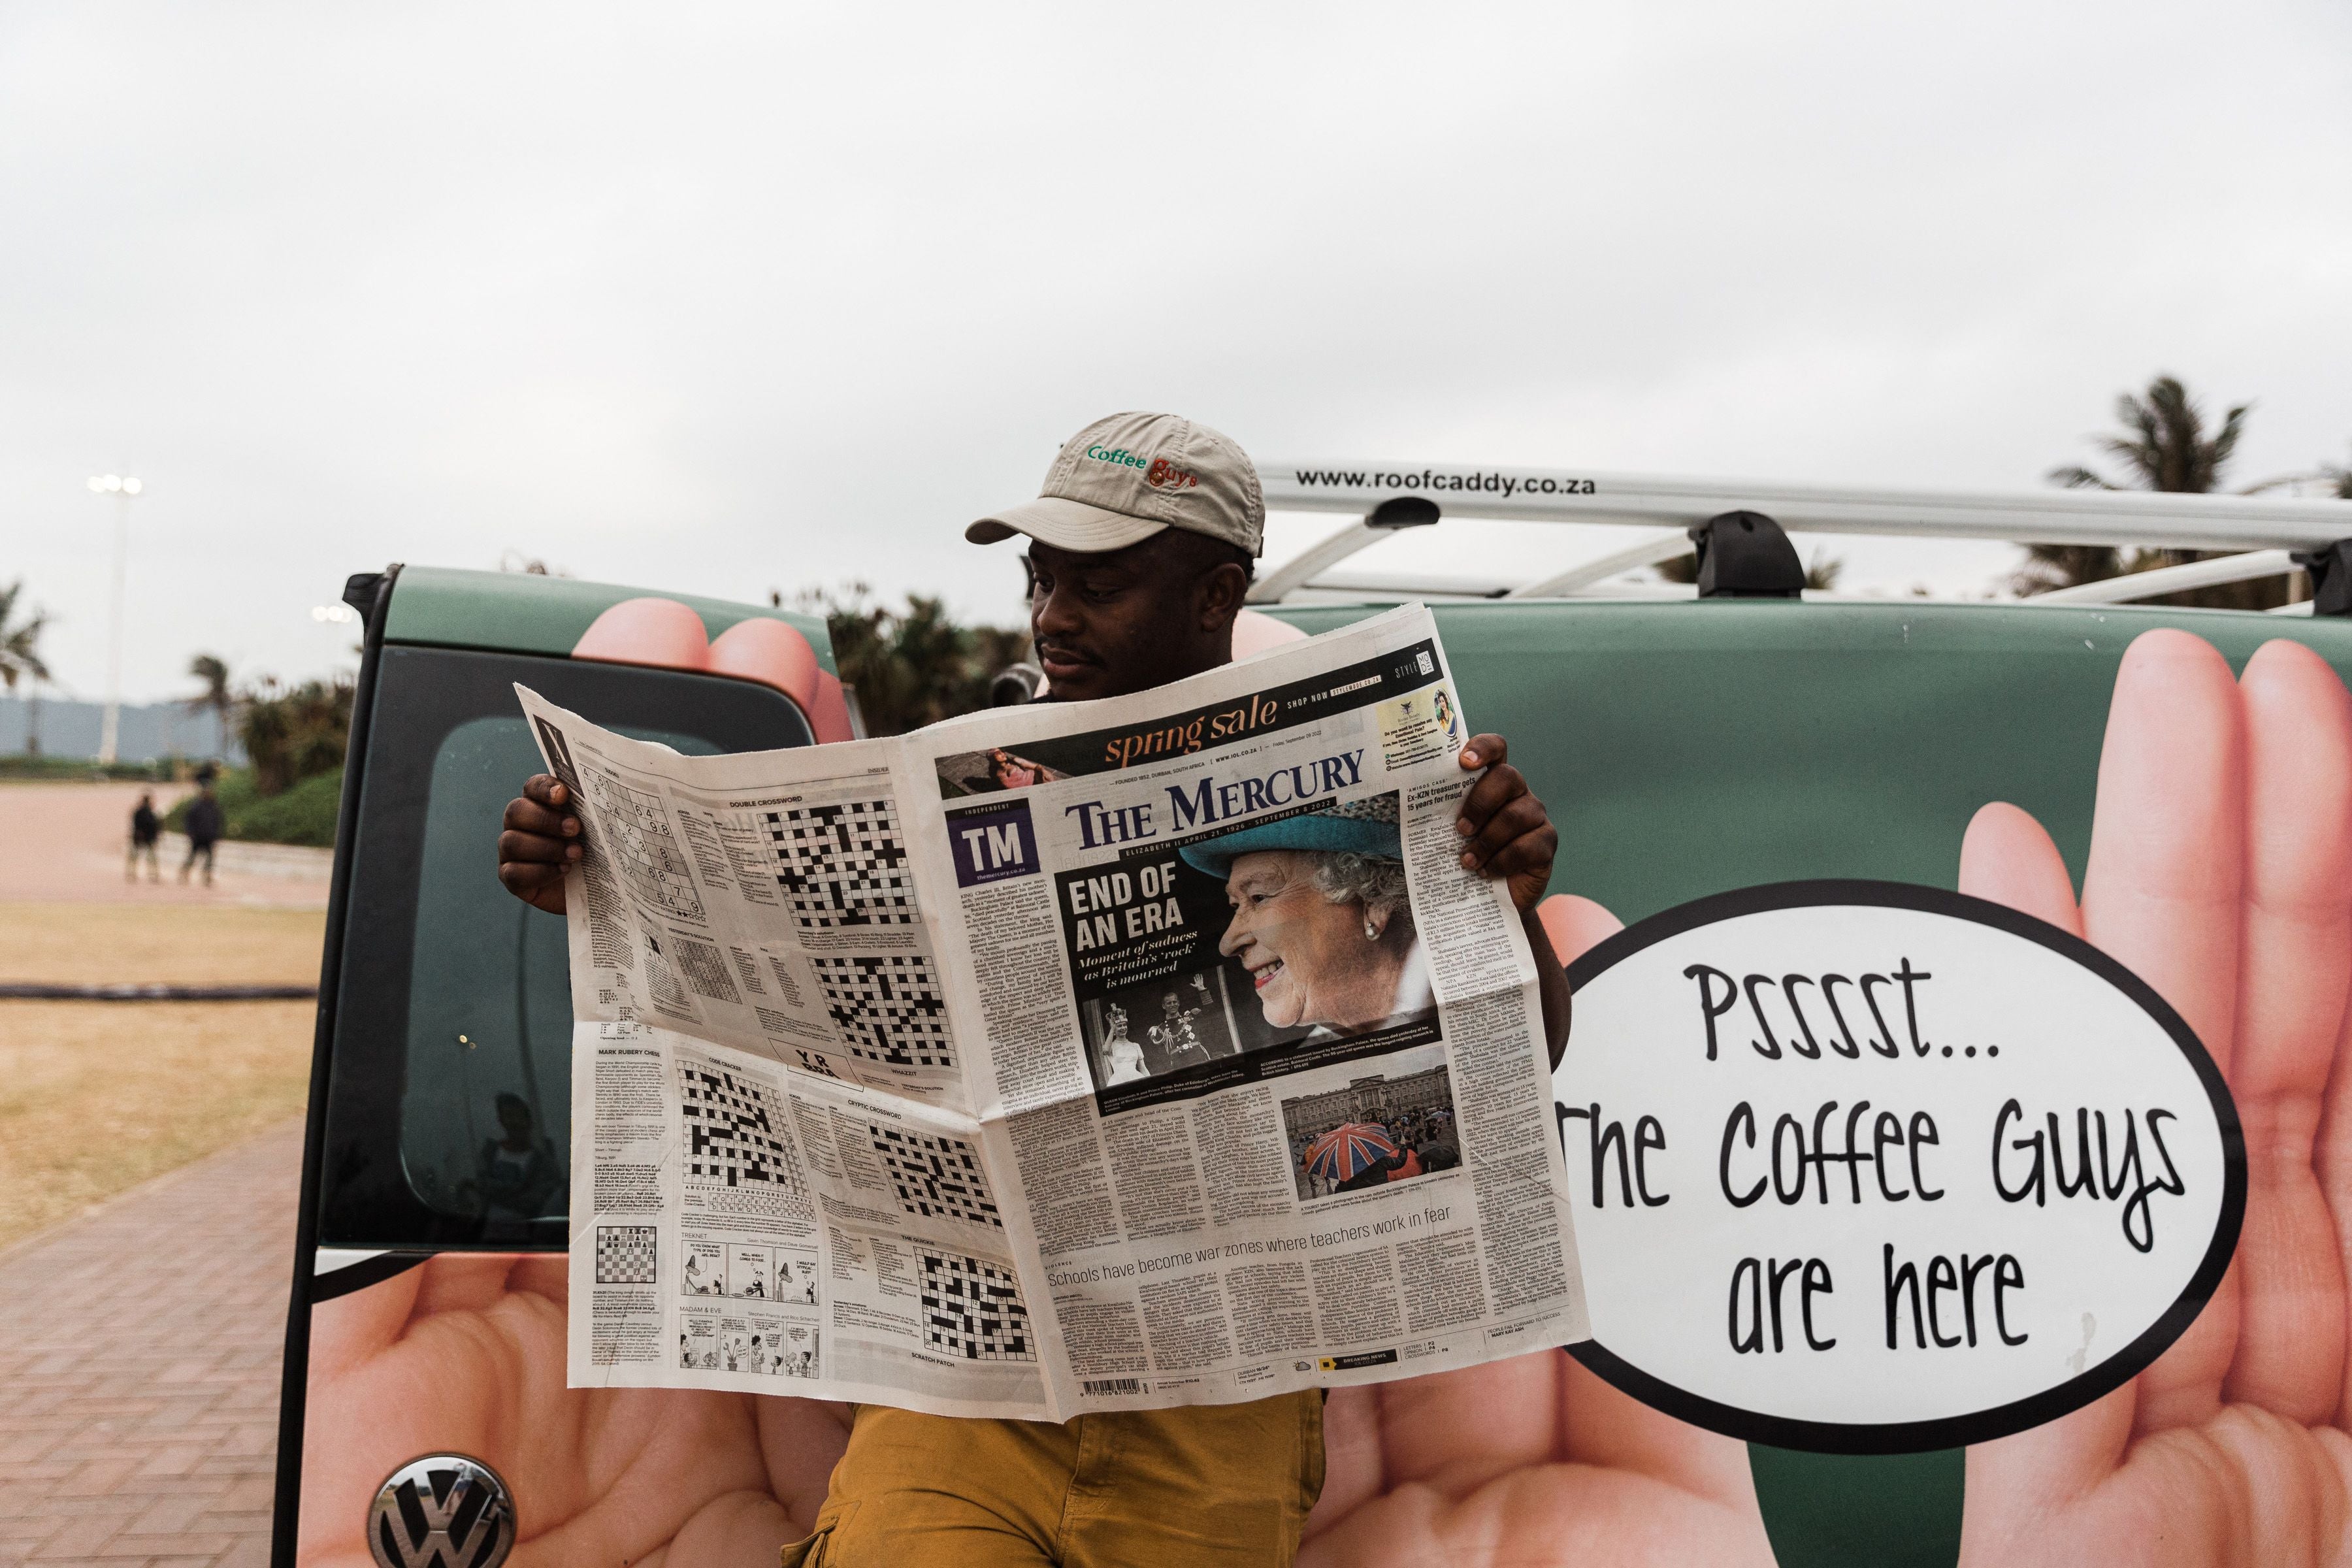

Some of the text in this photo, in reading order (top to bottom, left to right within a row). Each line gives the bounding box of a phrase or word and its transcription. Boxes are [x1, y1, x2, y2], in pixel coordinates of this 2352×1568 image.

[1088, 446, 1147, 469] Coffee
[1297, 470, 1595, 497] www.roofcaddy.co.za
[1395, 661, 1418, 679] STYLE
[1287, 676, 1380, 710] SHOP NOW STYLEMODE.CO.ZA
[1105, 694, 1277, 768] spring sale
[1285, 735, 1305, 744] September
[1215, 747, 1257, 763] WWW.IOL.CO.ZA
[1115, 776, 1138, 785] FOUNDED
[1172, 766, 1188, 774] SOUTH
[1188, 762, 1205, 770] AFRICA
[757, 796, 803, 806] CROSSWORD
[1407, 777, 1475, 802] Ex-KZN treasurer gets
[1414, 799, 1433, 811] years
[1434, 794, 1443, 803] for
[1445, 790, 1462, 800] fraud
[965, 803, 1010, 815] INDEPENDENT
[1255, 810, 1301, 825] SEPTEMBER
[1311, 800, 1331, 810] 2022
[962, 822, 1024, 872] TM
[1126, 841, 1171, 857] ELIZABETH
[1184, 832, 1207, 845] APRIL
[1227, 823, 1245, 832] 1926
[977, 867, 1026, 881] themercury.co.za
[1069, 861, 1176, 915] END OF
[1077, 897, 1184, 952] AN ERA
[1078, 930, 1198, 970] Moment of sadness
[1085, 972, 1099, 981] as
[1102, 953, 1157, 977] Britain's
[1107, 960, 1178, 988] is mourned
[708, 1057, 742, 1072] CODE CRACKER
[848, 1099, 902, 1120] CRYPTIC CROSSWORD
[1720, 1101, 1944, 1208] Coffee
[1991, 1098, 2187, 1253] Guys
[1333, 1196, 1354, 1206] photograph
[1386, 1185, 1408, 1194] Buckingham
[1315, 1205, 1331, 1214] gathered
[913, 1237, 936, 1246] QUICKIE
[1047, 1207, 1450, 1286] Schools have become war zones where teachers work in fear
[1045, 1260, 1073, 1270] VIOLENCE
[1727, 1243, 2029, 1354] are here
[1513, 1319, 1535, 1328] FORWARD
[1541, 1311, 1561, 1321] SUCCESS
[911, 1352, 955, 1368] SCRATCH PATCH
[1405, 1349, 1435, 1360] CROSSWORDS
